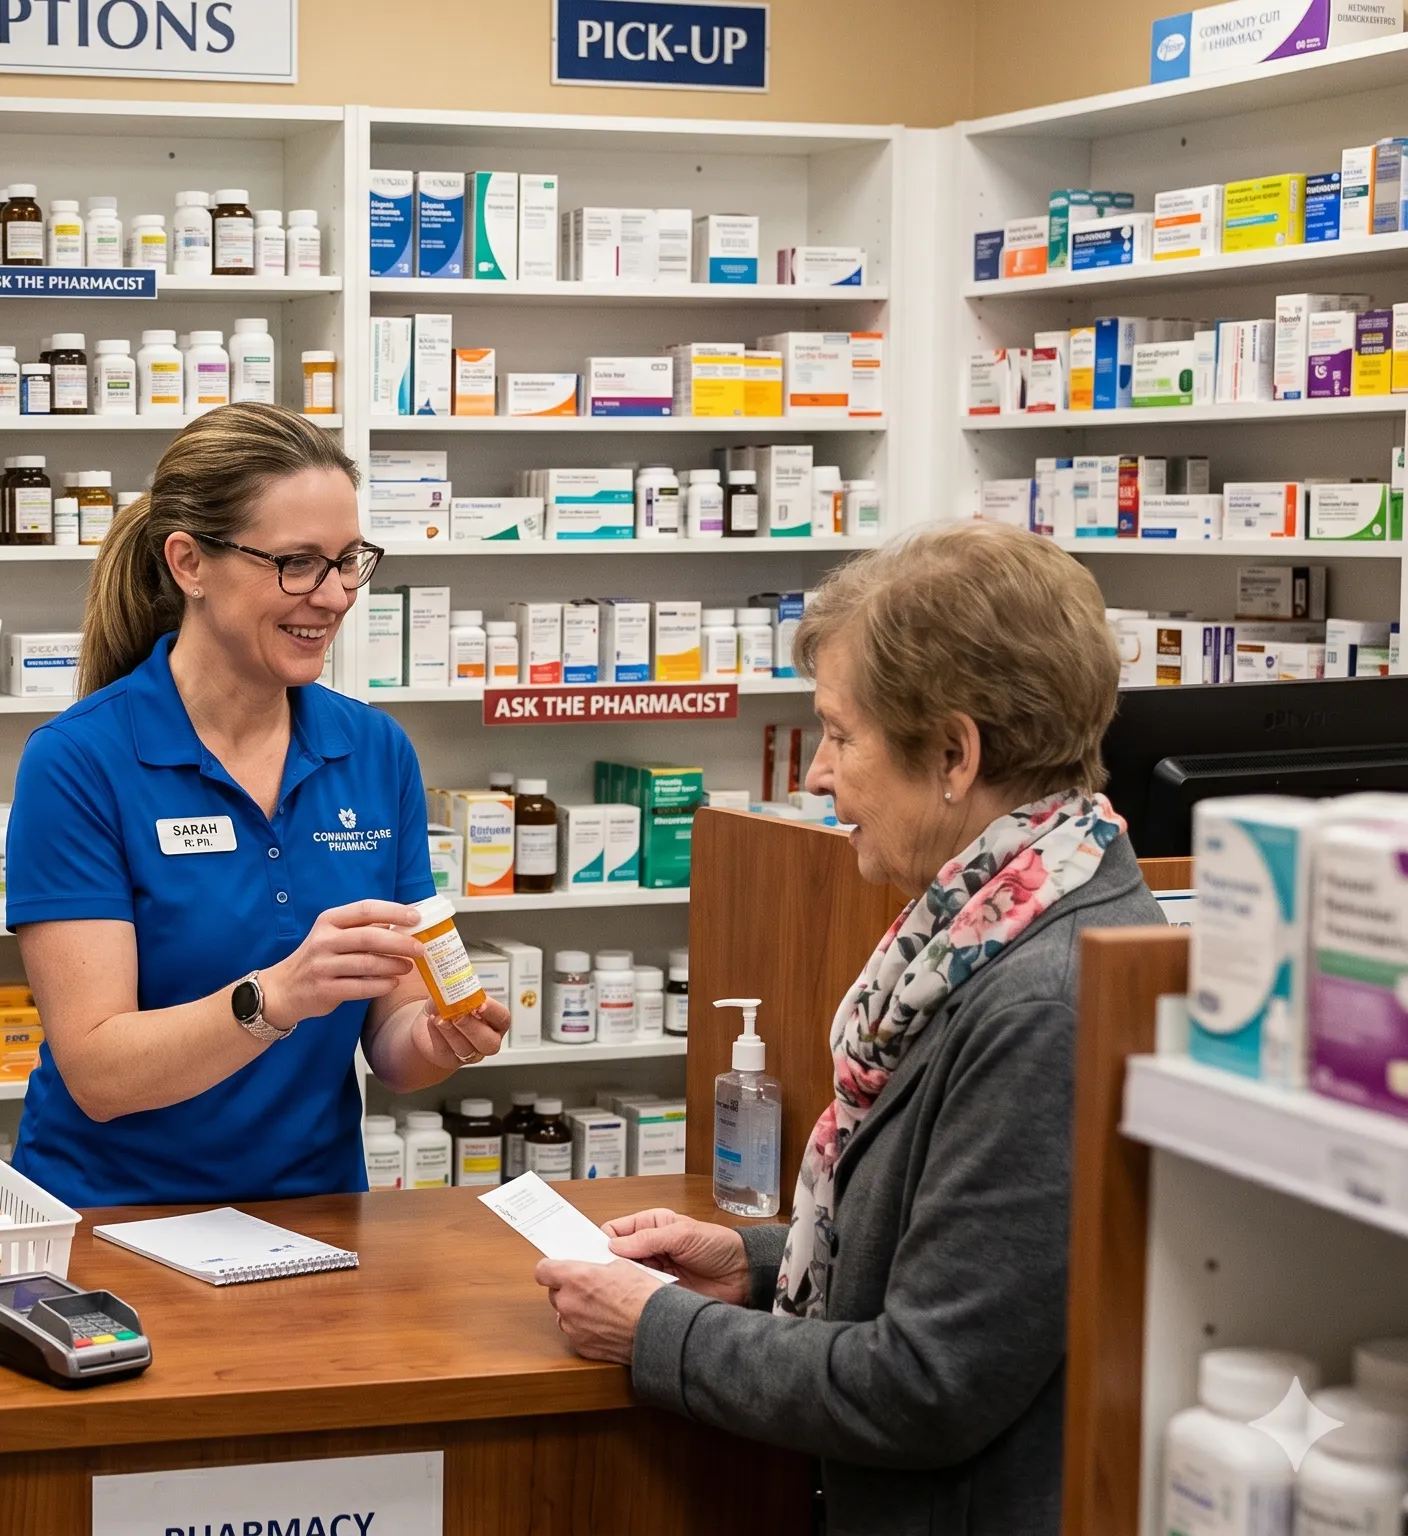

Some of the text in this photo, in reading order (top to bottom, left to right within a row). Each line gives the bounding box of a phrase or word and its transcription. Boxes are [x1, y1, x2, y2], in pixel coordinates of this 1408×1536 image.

[578, 19, 748, 65] PICK-UP
[15, 276, 44, 289] THE
[48, 276, 144, 290] PHARMACIST
[494, 692, 730, 717] ASK THE PHARMACIST
[172, 823, 218, 836] SARAH
[366, 829, 392, 840] CARE
